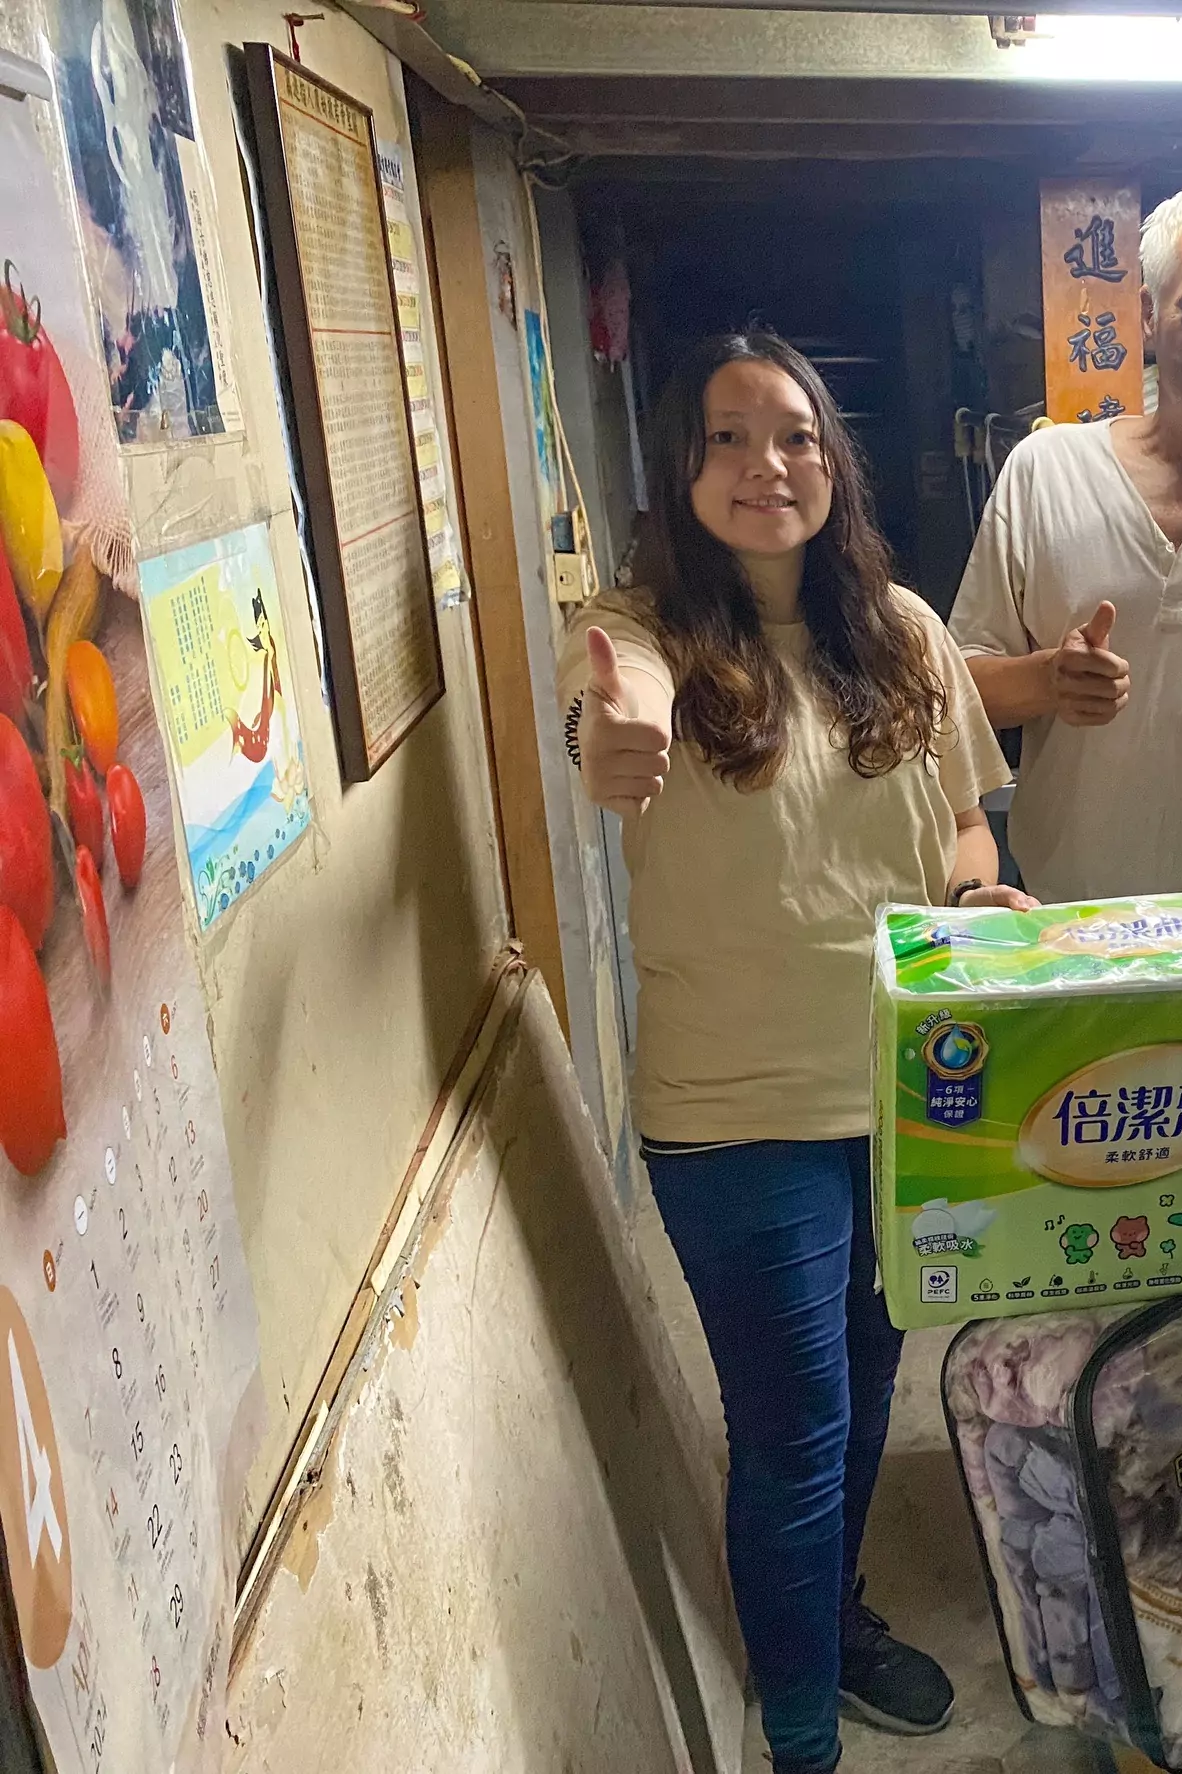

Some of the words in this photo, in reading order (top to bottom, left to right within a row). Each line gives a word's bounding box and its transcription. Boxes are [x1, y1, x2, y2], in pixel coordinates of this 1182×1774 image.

[91, 1260, 99, 1289] 1
[119, 1207, 128, 1240] 2
[171, 1054, 178, 1079] 6
[930, 1096, 978, 1108] 純淨安心
[1105, 1147, 1170, 1163] 柔軟舒適
[112, 1347, 122, 1379] 8
[137, 1293, 145, 1323] 9
[185, 1120, 195, 1148] 13
[131, 1420, 144, 1462] 15
[155, 1364, 166, 1401] 16
[198, 1188, 209, 1222] 20
[919, 1239, 973, 1257] 柔軟吸水
[8, 1327, 63, 1570] 4
[147, 1503, 163, 1550] 22
[169, 1443, 183, 1486] 23
[210, 1254, 220, 1290] 27
[169, 1583, 184, 1629] 29
